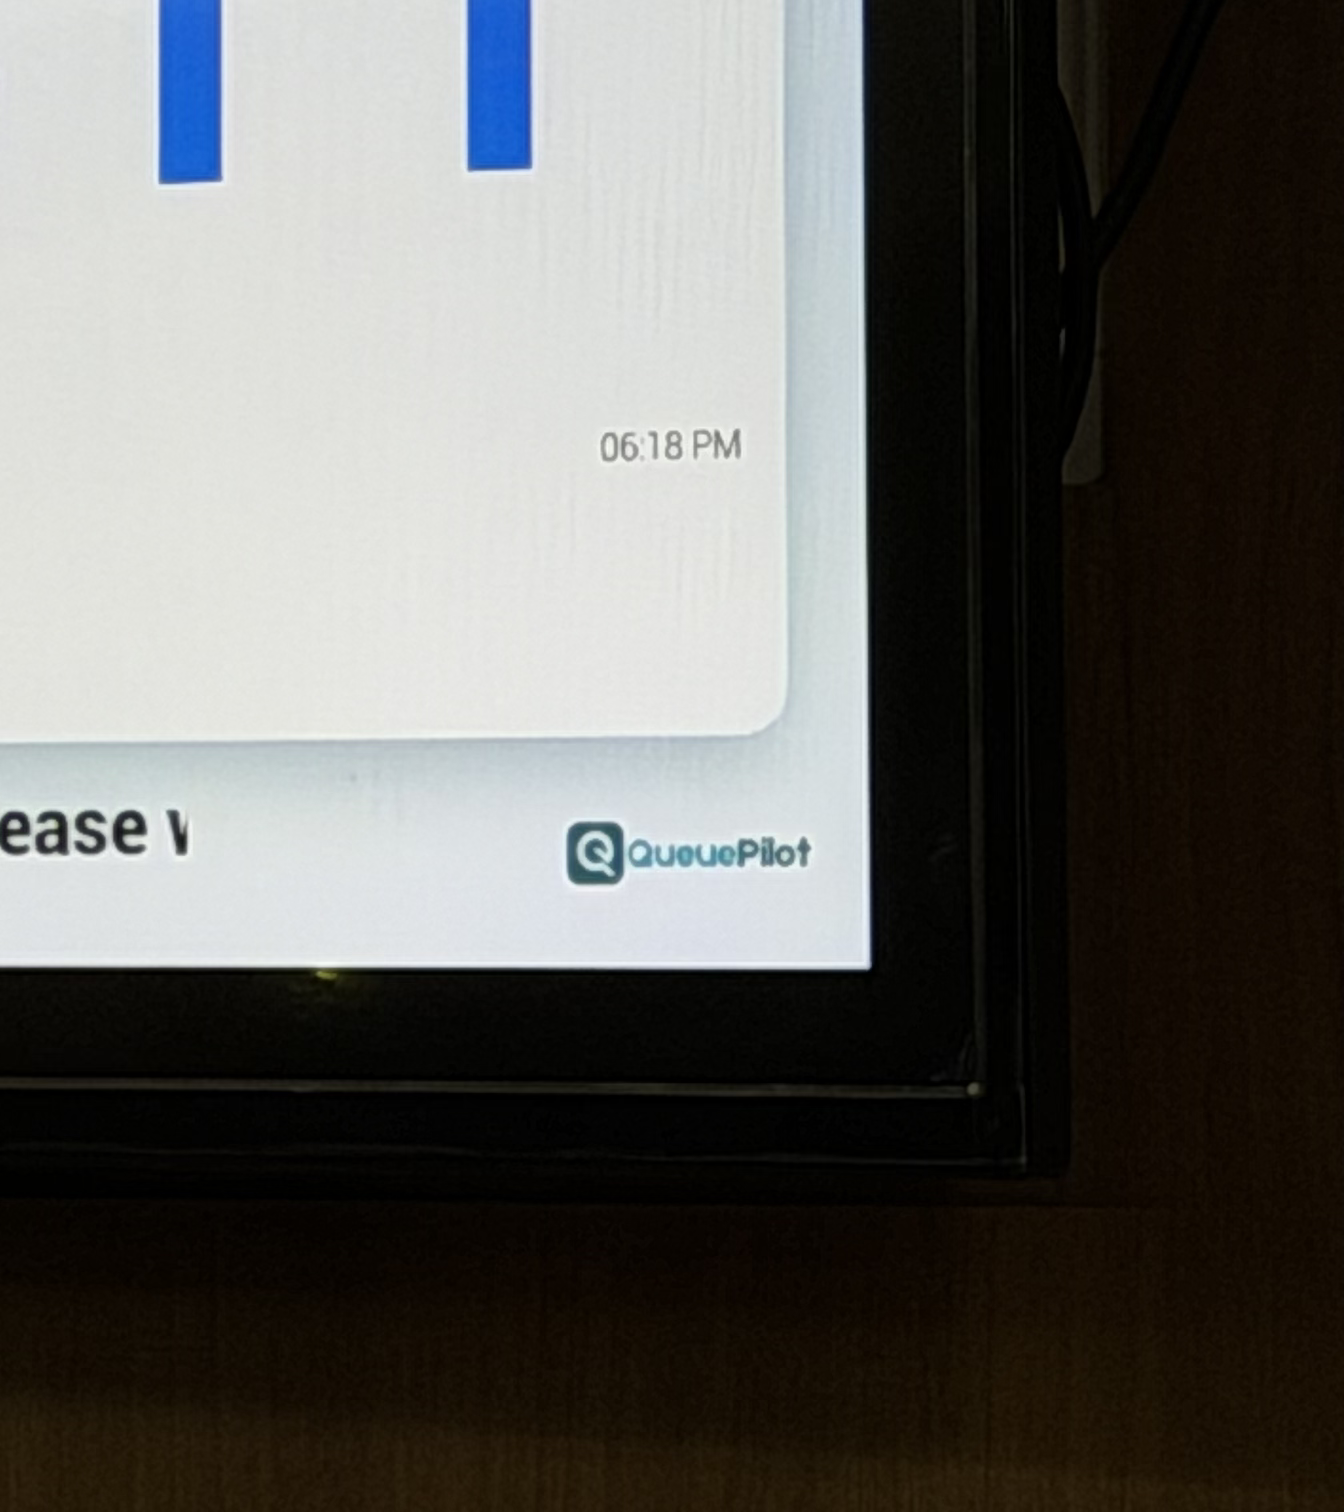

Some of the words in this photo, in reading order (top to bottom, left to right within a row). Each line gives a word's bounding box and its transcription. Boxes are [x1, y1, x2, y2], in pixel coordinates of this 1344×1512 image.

[600, 430, 683, 463] 06:18
[693, 428, 742, 459] PM
[627, 836, 812, 868] QueuePilot
